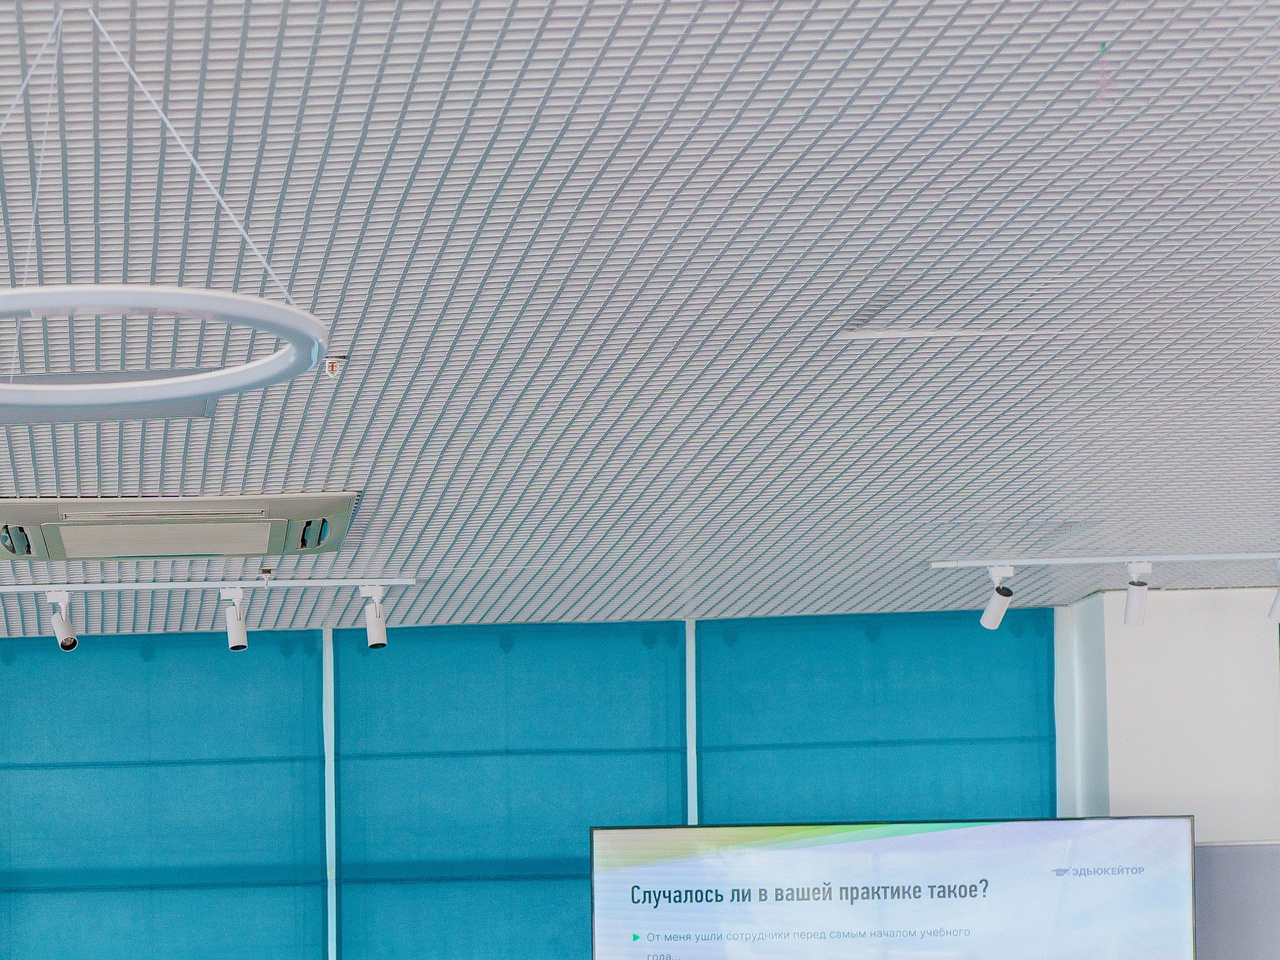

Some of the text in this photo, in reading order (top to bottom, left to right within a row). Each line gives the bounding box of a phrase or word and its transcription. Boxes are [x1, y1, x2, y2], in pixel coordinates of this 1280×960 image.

[1072, 866, 1145, 877] ЭДЬЮКЕЙТОР
[630, 878, 989, 908] Случалось ли в вашей практике такое?
[646, 927, 970, 943] От меня ушли сотрудники перед самым началом учебного
